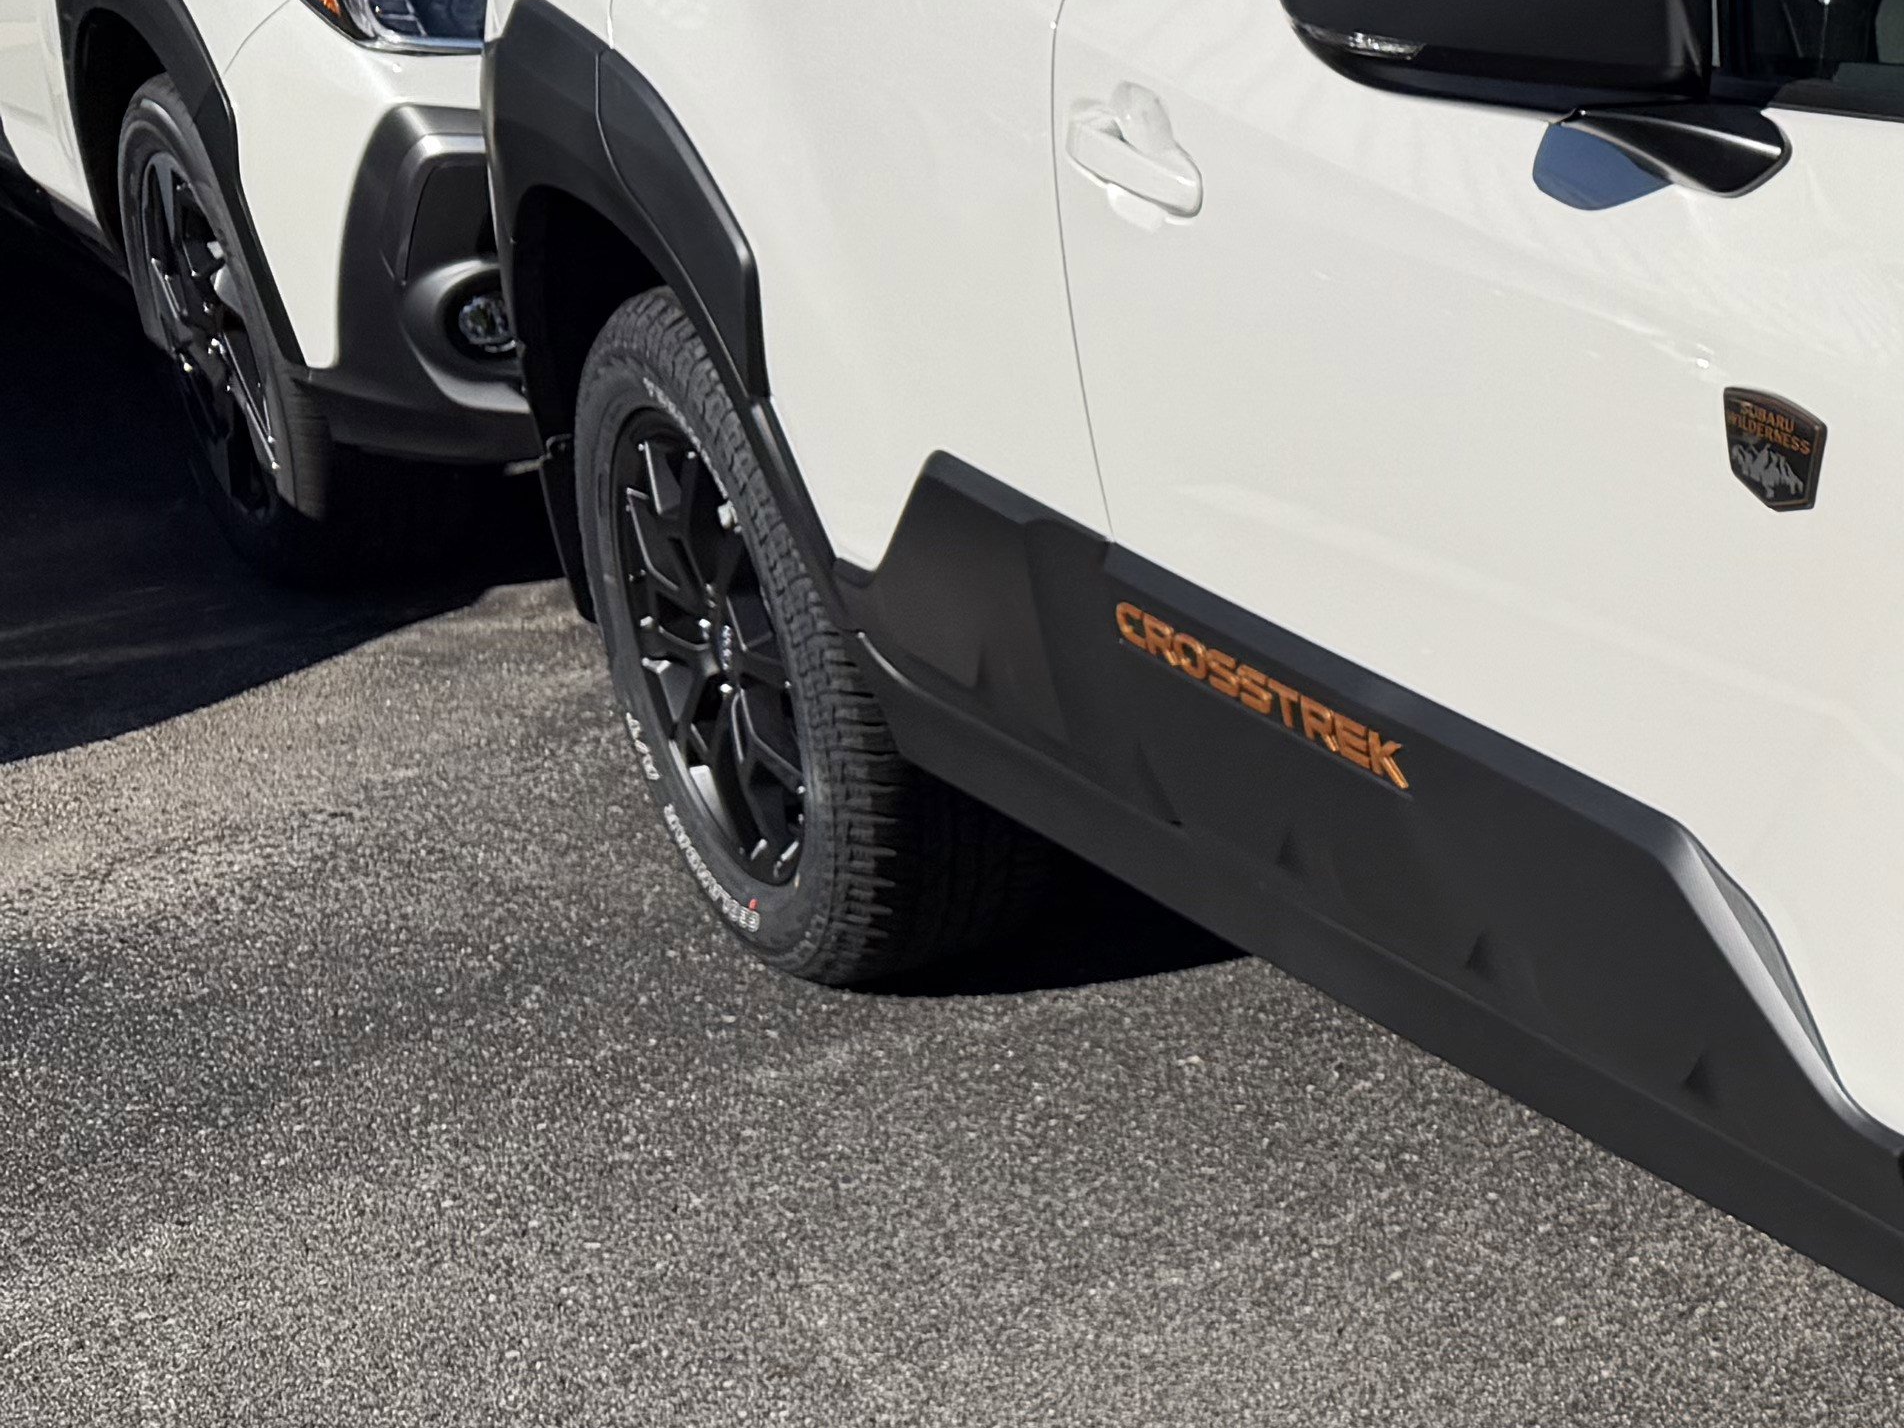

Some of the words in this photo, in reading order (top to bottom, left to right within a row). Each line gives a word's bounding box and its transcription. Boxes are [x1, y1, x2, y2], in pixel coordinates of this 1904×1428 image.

[1727, 411, 1811, 455] WILDERNESS
[1740, 399, 1796, 433] SUBARU
[1115, 601, 1410, 790] CROSSTREK
